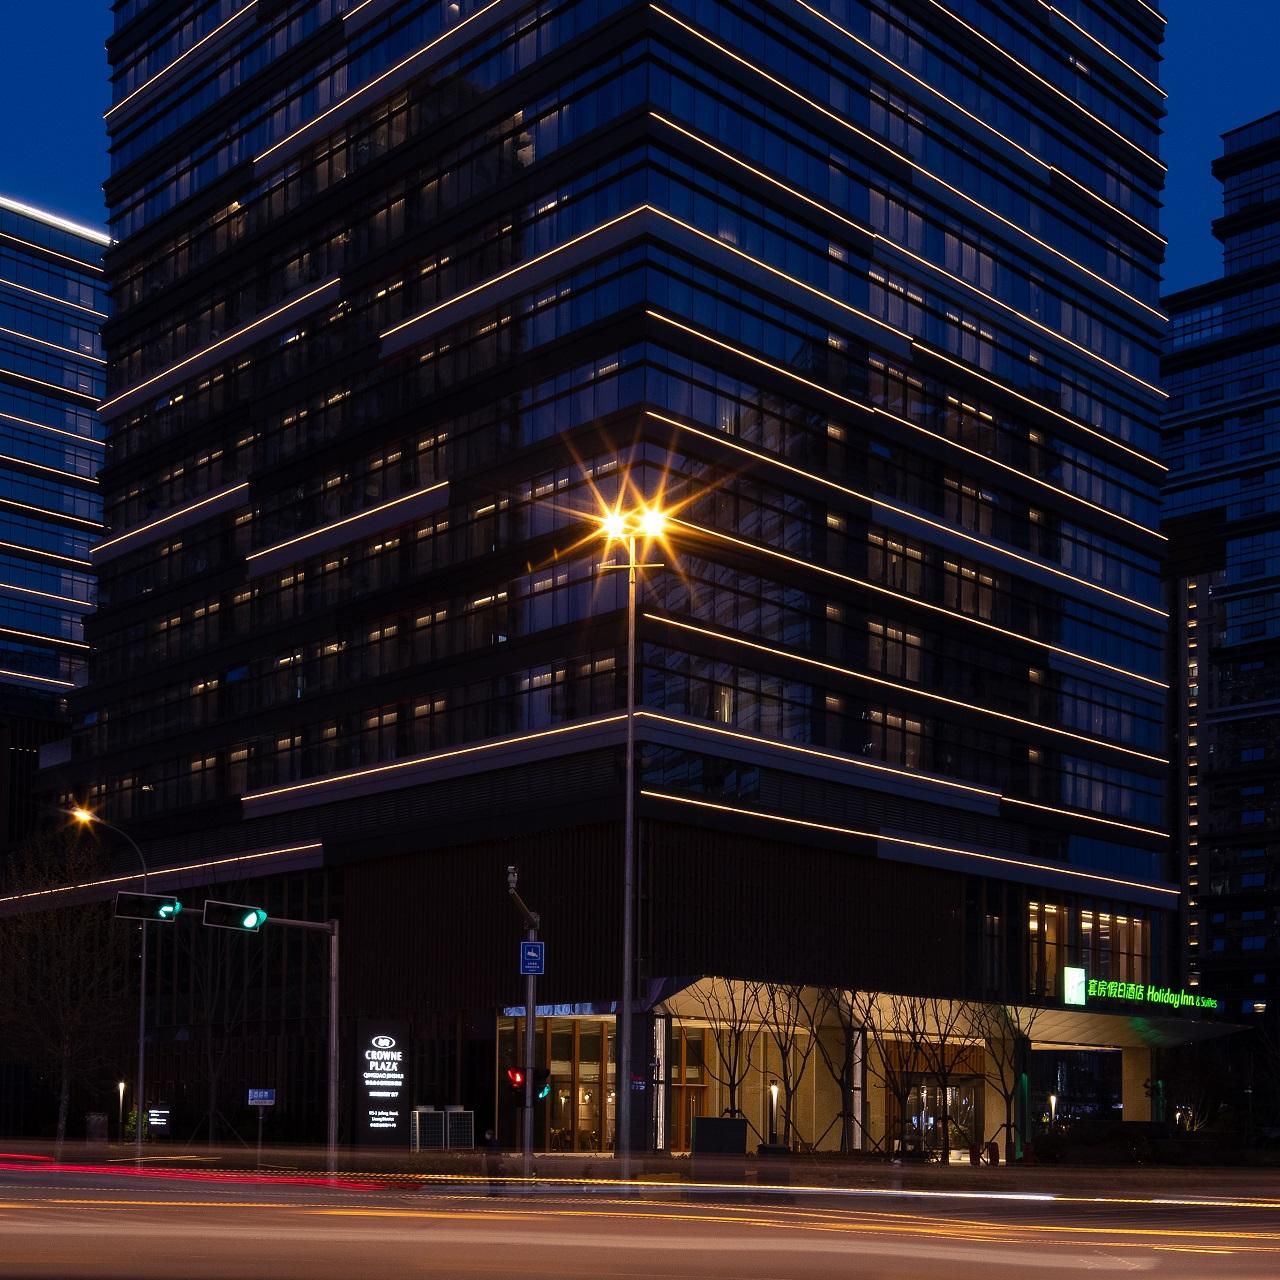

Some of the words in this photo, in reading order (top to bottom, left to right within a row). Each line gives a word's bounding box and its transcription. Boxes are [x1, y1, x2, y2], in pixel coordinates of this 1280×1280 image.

[1087, 978, 1145, 1001] 套房假日酒店
[1147, 985, 1180, 1008] Holiday
[1180, 989, 1195, 1006] Inn
[364, 1050, 403, 1061] CROWNE
[369, 1061, 399, 1071] PLAZA
